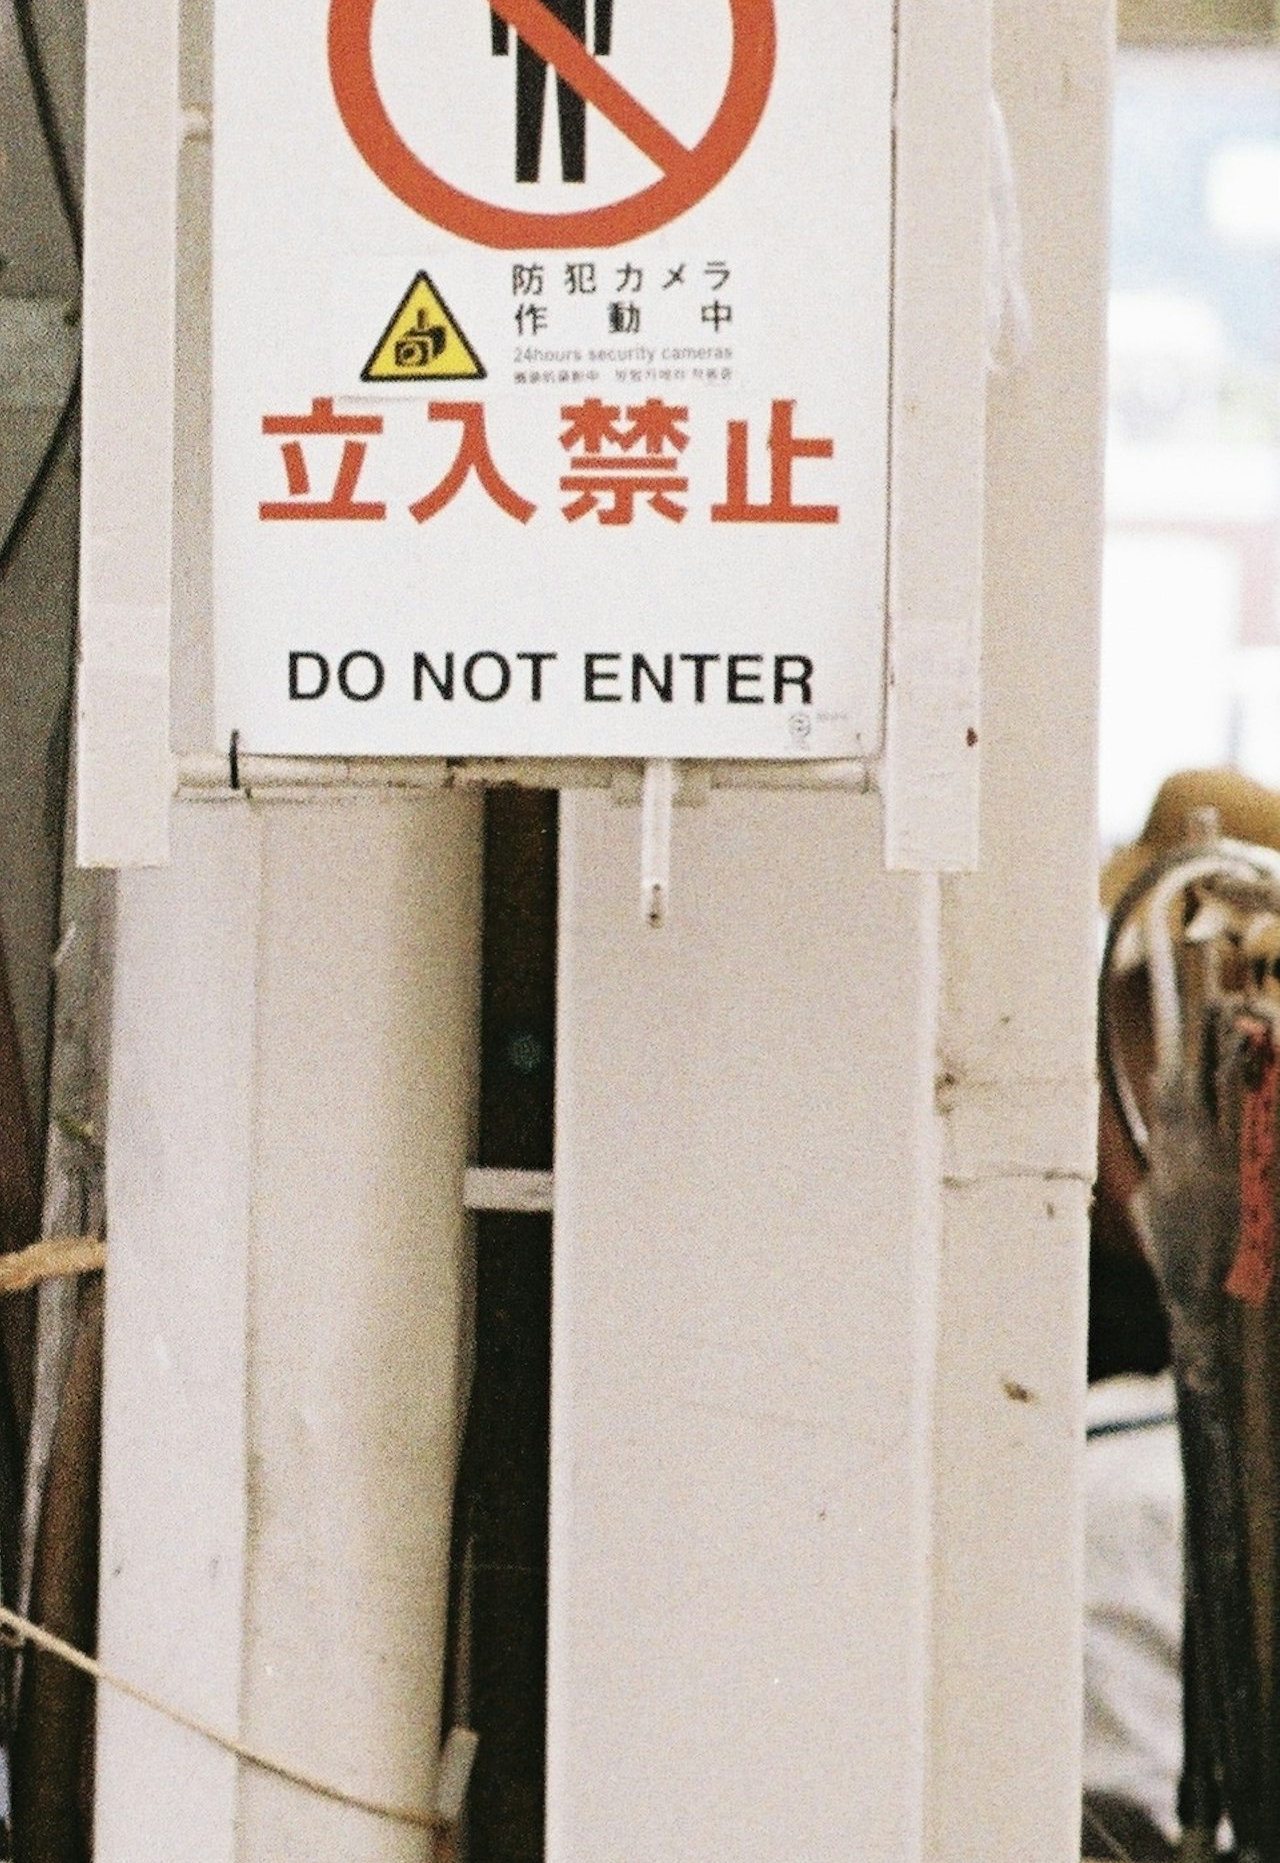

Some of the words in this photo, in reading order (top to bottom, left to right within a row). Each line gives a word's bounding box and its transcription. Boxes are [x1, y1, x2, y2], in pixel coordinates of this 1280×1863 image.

[511, 261, 732, 296] 防犯カメラ
[513, 299, 733, 335] 作動中
[513, 346, 582, 363] 24hours
[589, 345, 655, 366] security
[661, 346, 733, 361] cameras
[258, 396, 840, 527] 立入禁止
[288, 650, 384, 702] DO
[414, 651, 556, 702] NOT
[584, 652, 814, 704] ENTER
